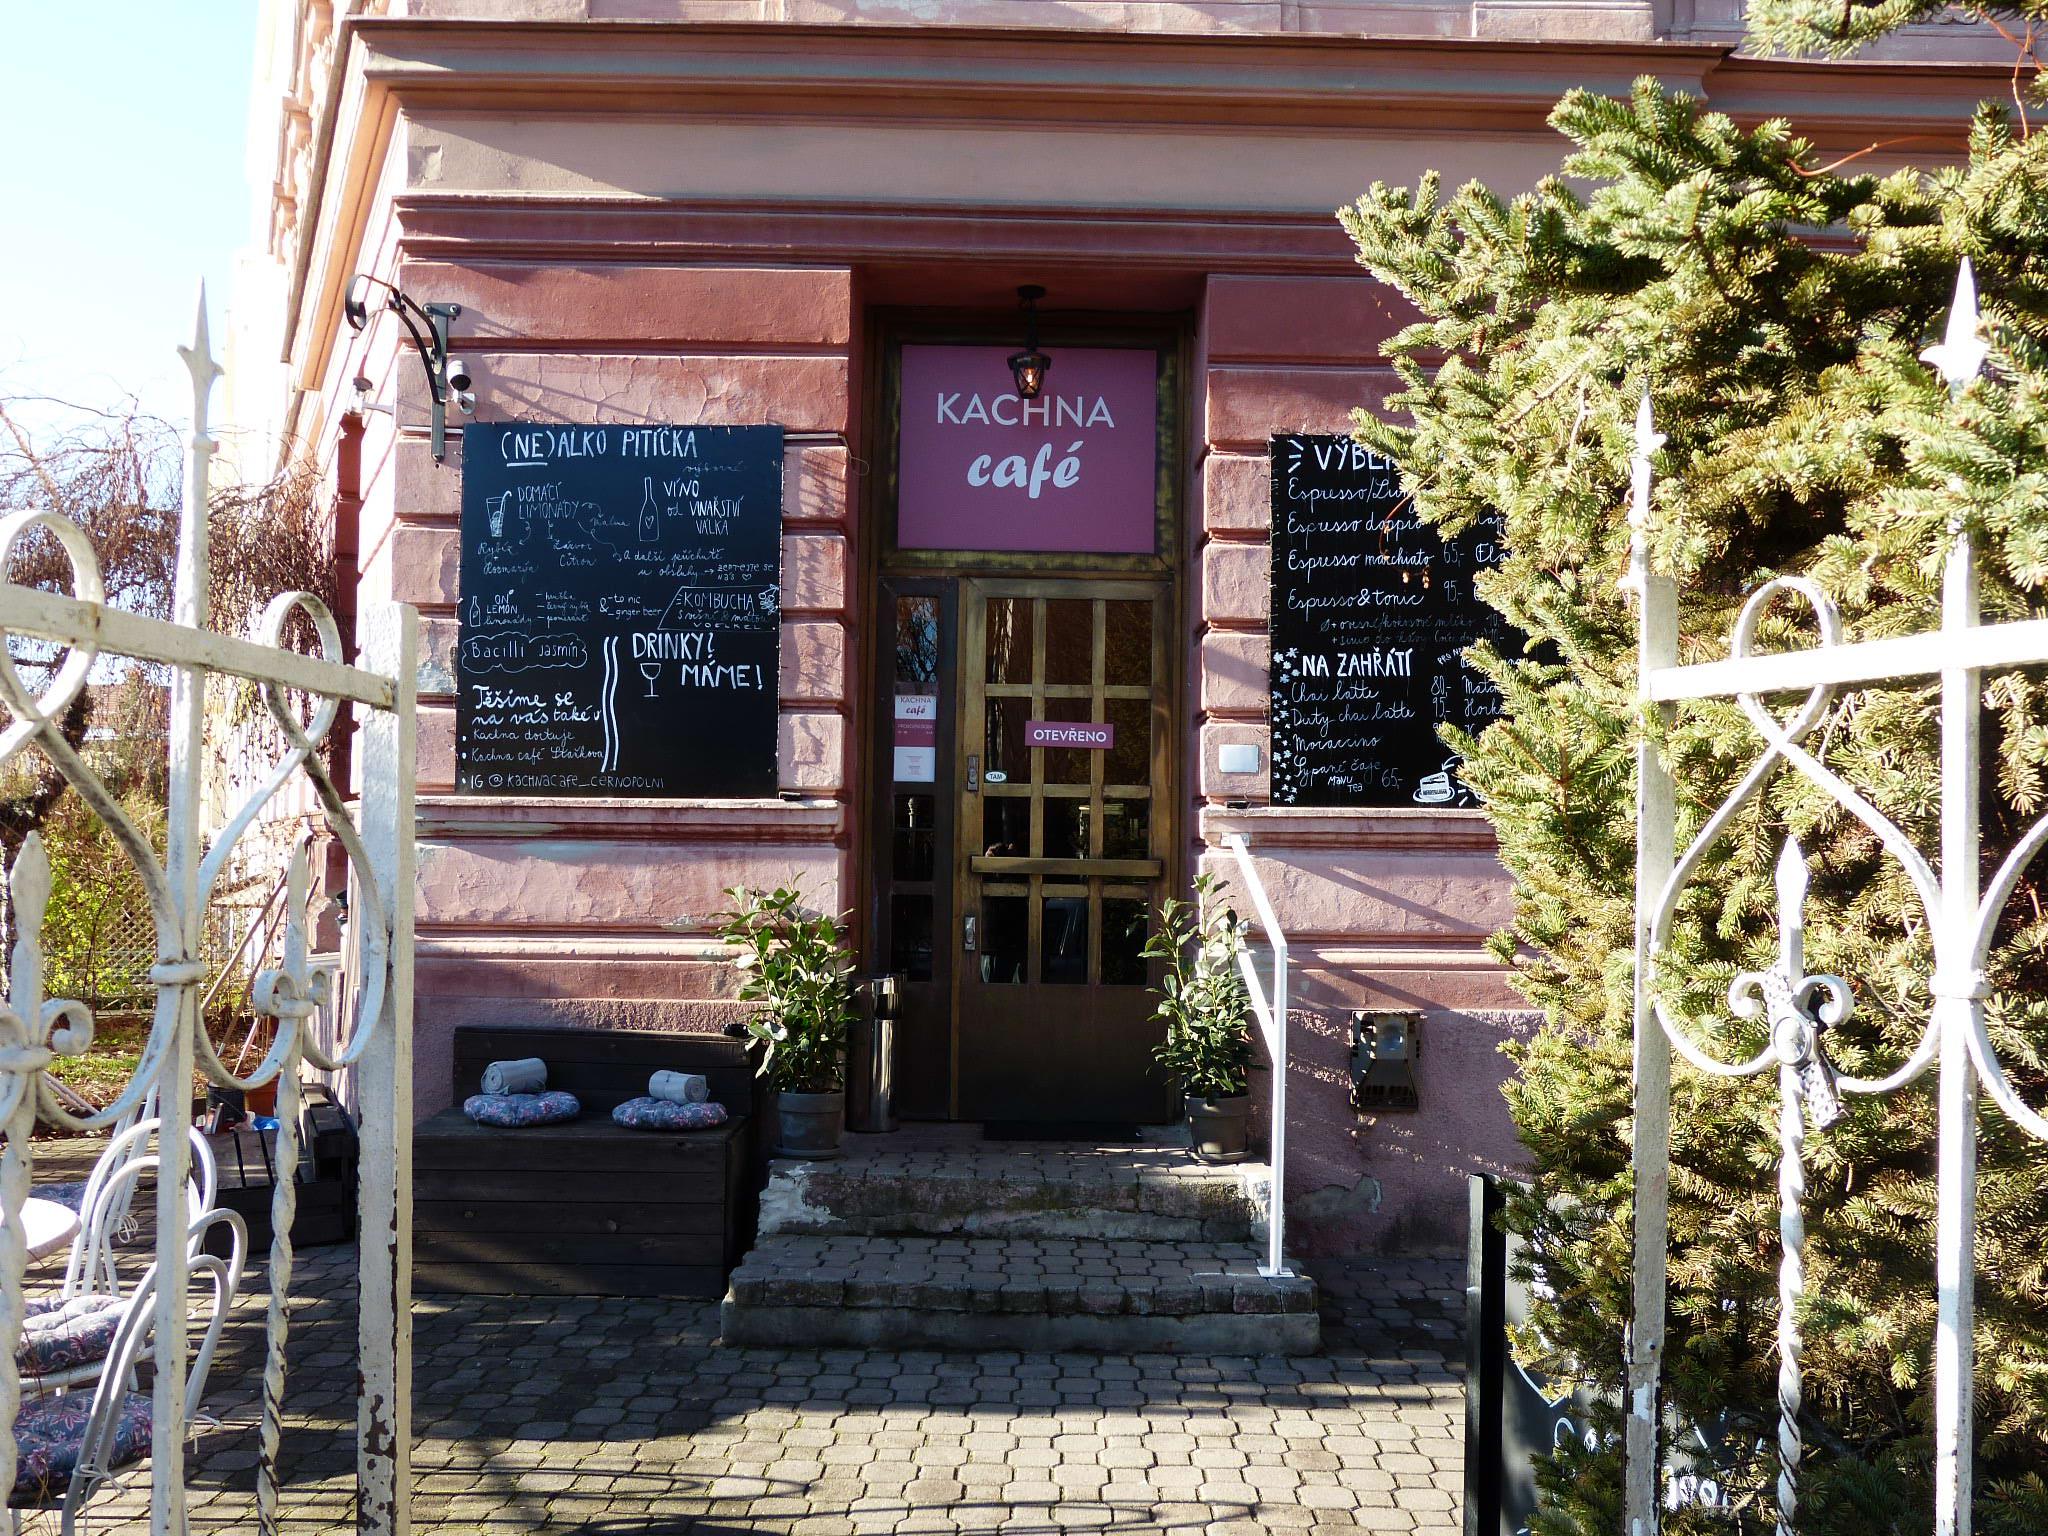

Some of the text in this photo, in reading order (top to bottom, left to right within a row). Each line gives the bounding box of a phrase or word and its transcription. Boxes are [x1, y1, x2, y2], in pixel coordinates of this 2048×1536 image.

[937, 392, 1115, 428] KACHNA
[622, 426, 698, 459] PITÍČKA
[967, 440, 1084, 499] café
[518, 481, 562, 502] DOMÁCÍ
[663, 477, 699, 498] VÍNO
[519, 500, 579, 520] LIMONÁDY
[667, 495, 744, 518] od VINAŘSTVÍ
[695, 519, 728, 535] VÁLKA
[1288, 511, 1362, 550] Espresso
[634, 550, 666, 561] další
[671, 548, 724, 567] příchutě
[1288, 549, 1361, 583] Espresso
[486, 604, 518, 615] LEMON
[494, 594, 510, 605] ON
[684, 591, 756, 610] KOMBUCHA
[616, 608, 641, 620] ginger
[472, 641, 525, 659] Bacilli
[1302, 646, 1413, 677] NA ZAHŘÁTÍ
[554, 690, 575, 707] se
[1291, 682, 1329, 702] Chai
[1332, 679, 1380, 700] latte
[472, 705, 602, 726] na vás také v
[906, 705, 926, 716] café
[1290, 705, 1334, 737] Dirty
[1338, 703, 1370, 721] chai
[1371, 700, 1416, 720] latte
[473, 727, 575, 747] Kachna dortuje
[1033, 727, 1107, 743] OTEVŘENO
[1293, 734, 1381, 752] Mocaccino
[471, 747, 514, 762] Kachna
[518, 747, 545, 766] café
[988, 773, 1003, 781] TAM
[1293, 754, 1382, 787] Sypané čaje
